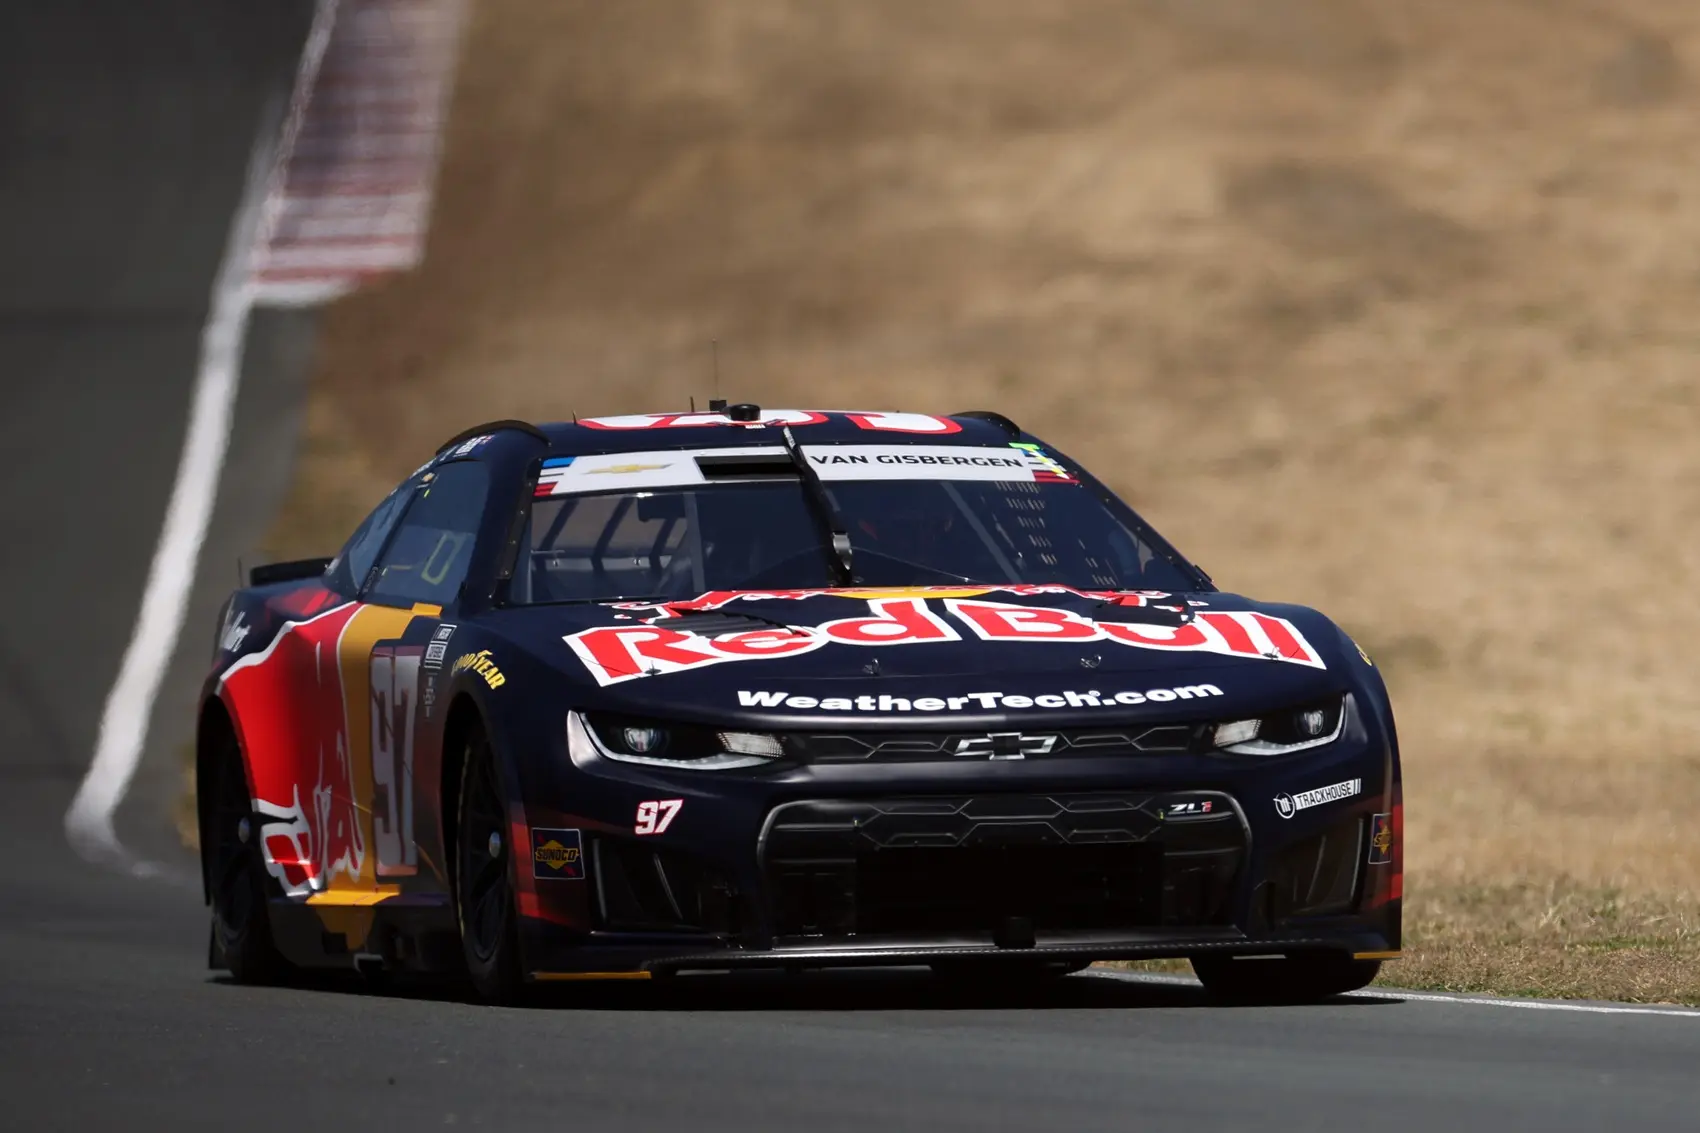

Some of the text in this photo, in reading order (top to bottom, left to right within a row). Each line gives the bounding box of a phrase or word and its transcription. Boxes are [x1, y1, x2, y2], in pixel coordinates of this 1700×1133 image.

[811, 455, 1023, 467] VAN GISBERGEN
[1297, 782, 1353, 806] TRACKHOUSE
[634, 799, 684, 836] 97
[536, 848, 578, 862] SUNOCO
